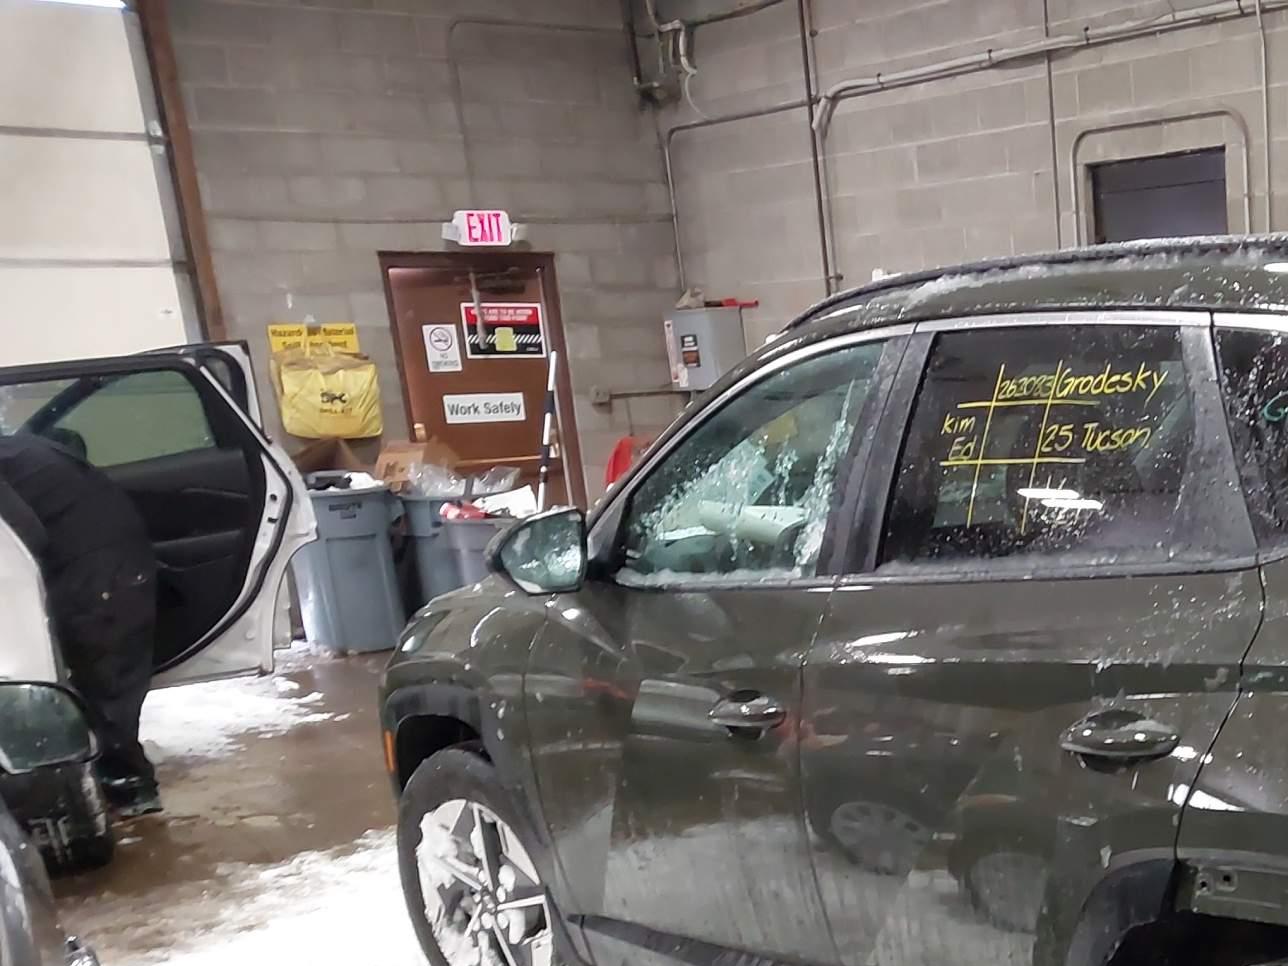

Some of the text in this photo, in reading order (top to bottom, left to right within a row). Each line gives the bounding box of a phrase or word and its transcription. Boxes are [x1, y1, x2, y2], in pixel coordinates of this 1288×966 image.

[466, 213, 503, 242] EXIT
[447, 401, 521, 416] Work Safely
[948, 434, 977, 461] Ed
[1041, 422, 1152, 453] 25 Tucson
